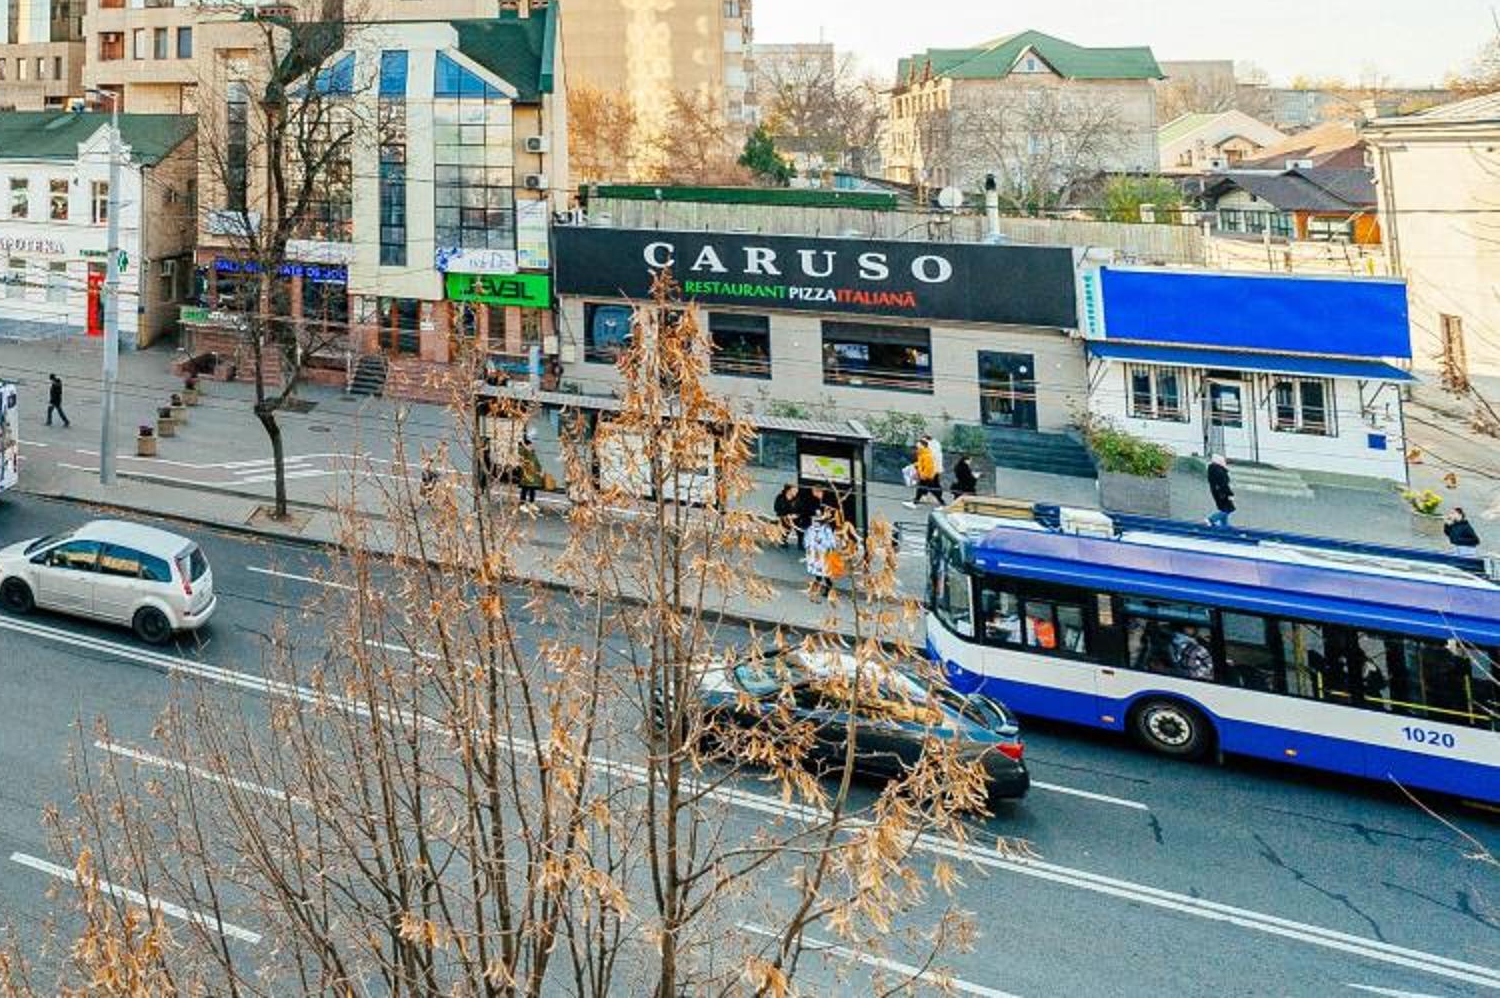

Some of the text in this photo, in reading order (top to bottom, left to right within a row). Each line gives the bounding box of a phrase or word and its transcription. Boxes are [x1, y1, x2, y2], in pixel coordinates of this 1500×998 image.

[642, 241, 953, 284] CARUSO
[684, 280, 786, 300] RESTAURANT
[788, 287, 837, 303] PIZZA
[1402, 726, 1455, 749] 1020
